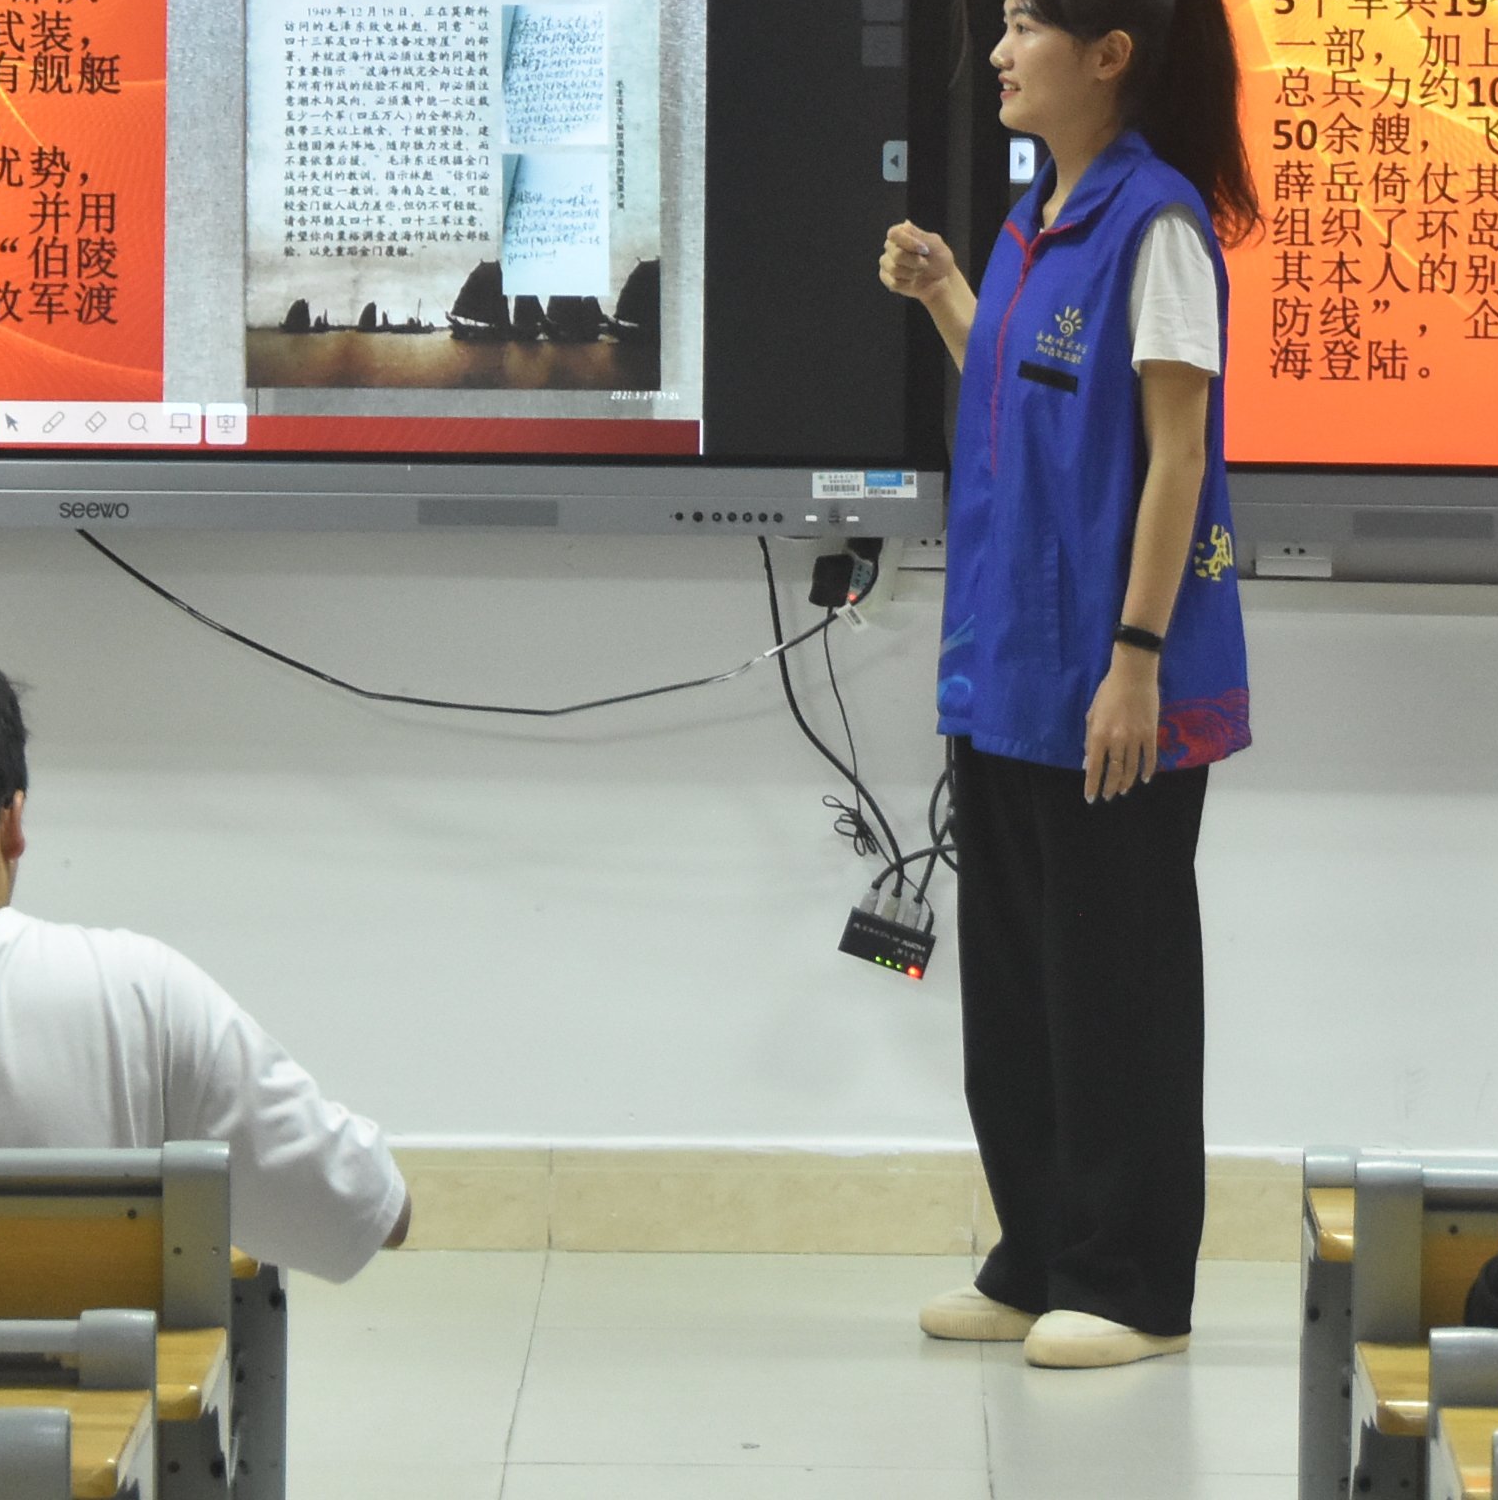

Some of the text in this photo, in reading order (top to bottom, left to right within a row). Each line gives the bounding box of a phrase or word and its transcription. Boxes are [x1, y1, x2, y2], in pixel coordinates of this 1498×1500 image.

[1269, 338, 1433, 380] 海登陆。
[59, 502, 130, 519] seewo
